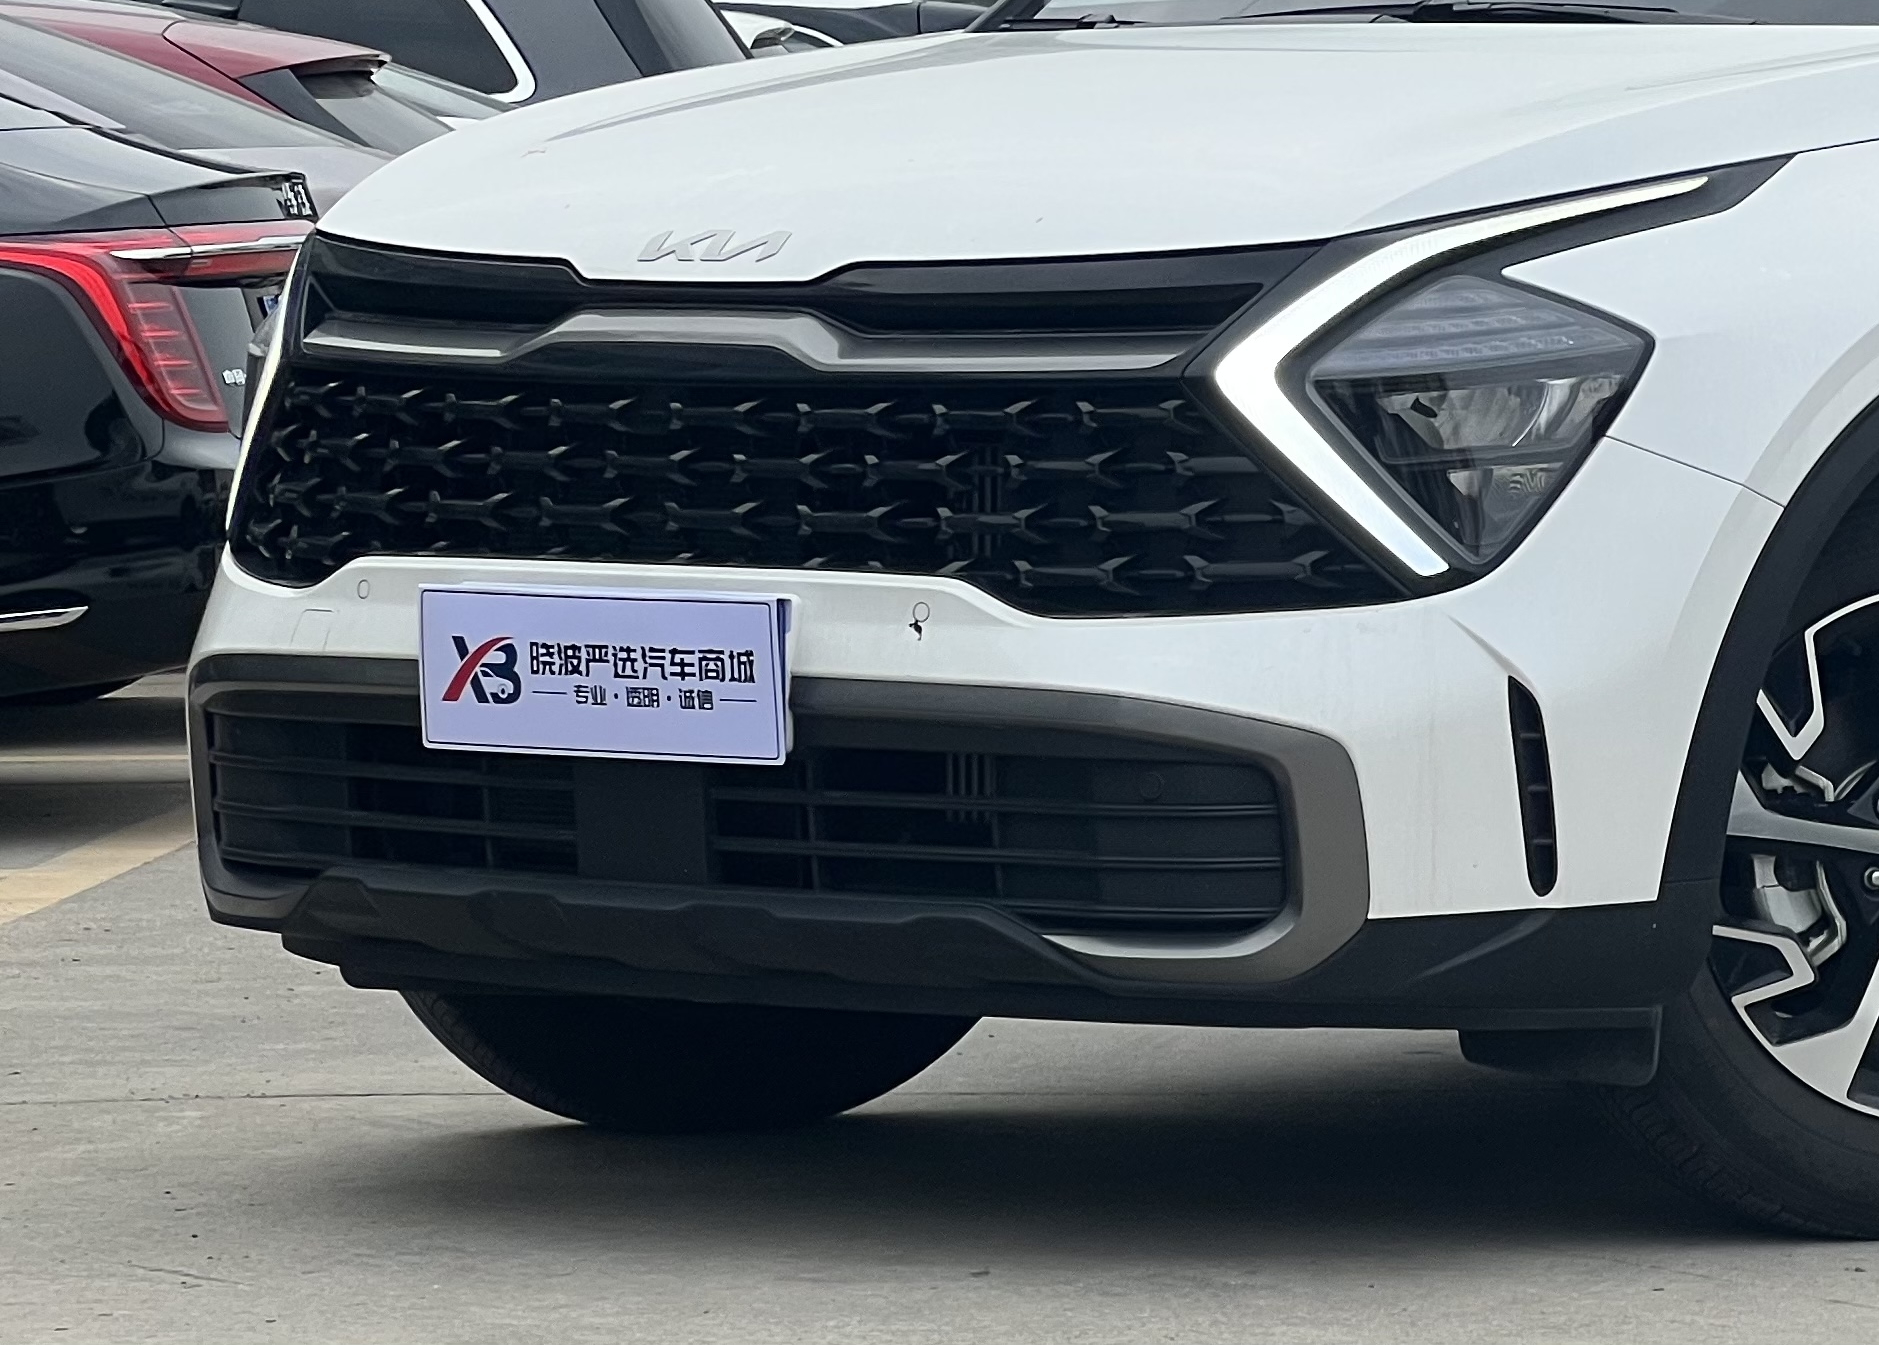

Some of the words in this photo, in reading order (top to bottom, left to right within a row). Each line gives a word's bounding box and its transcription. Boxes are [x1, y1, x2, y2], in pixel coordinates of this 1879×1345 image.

[637, 228, 793, 262] KIA
[529, 640, 756, 684] 晓波严选汽车商城
